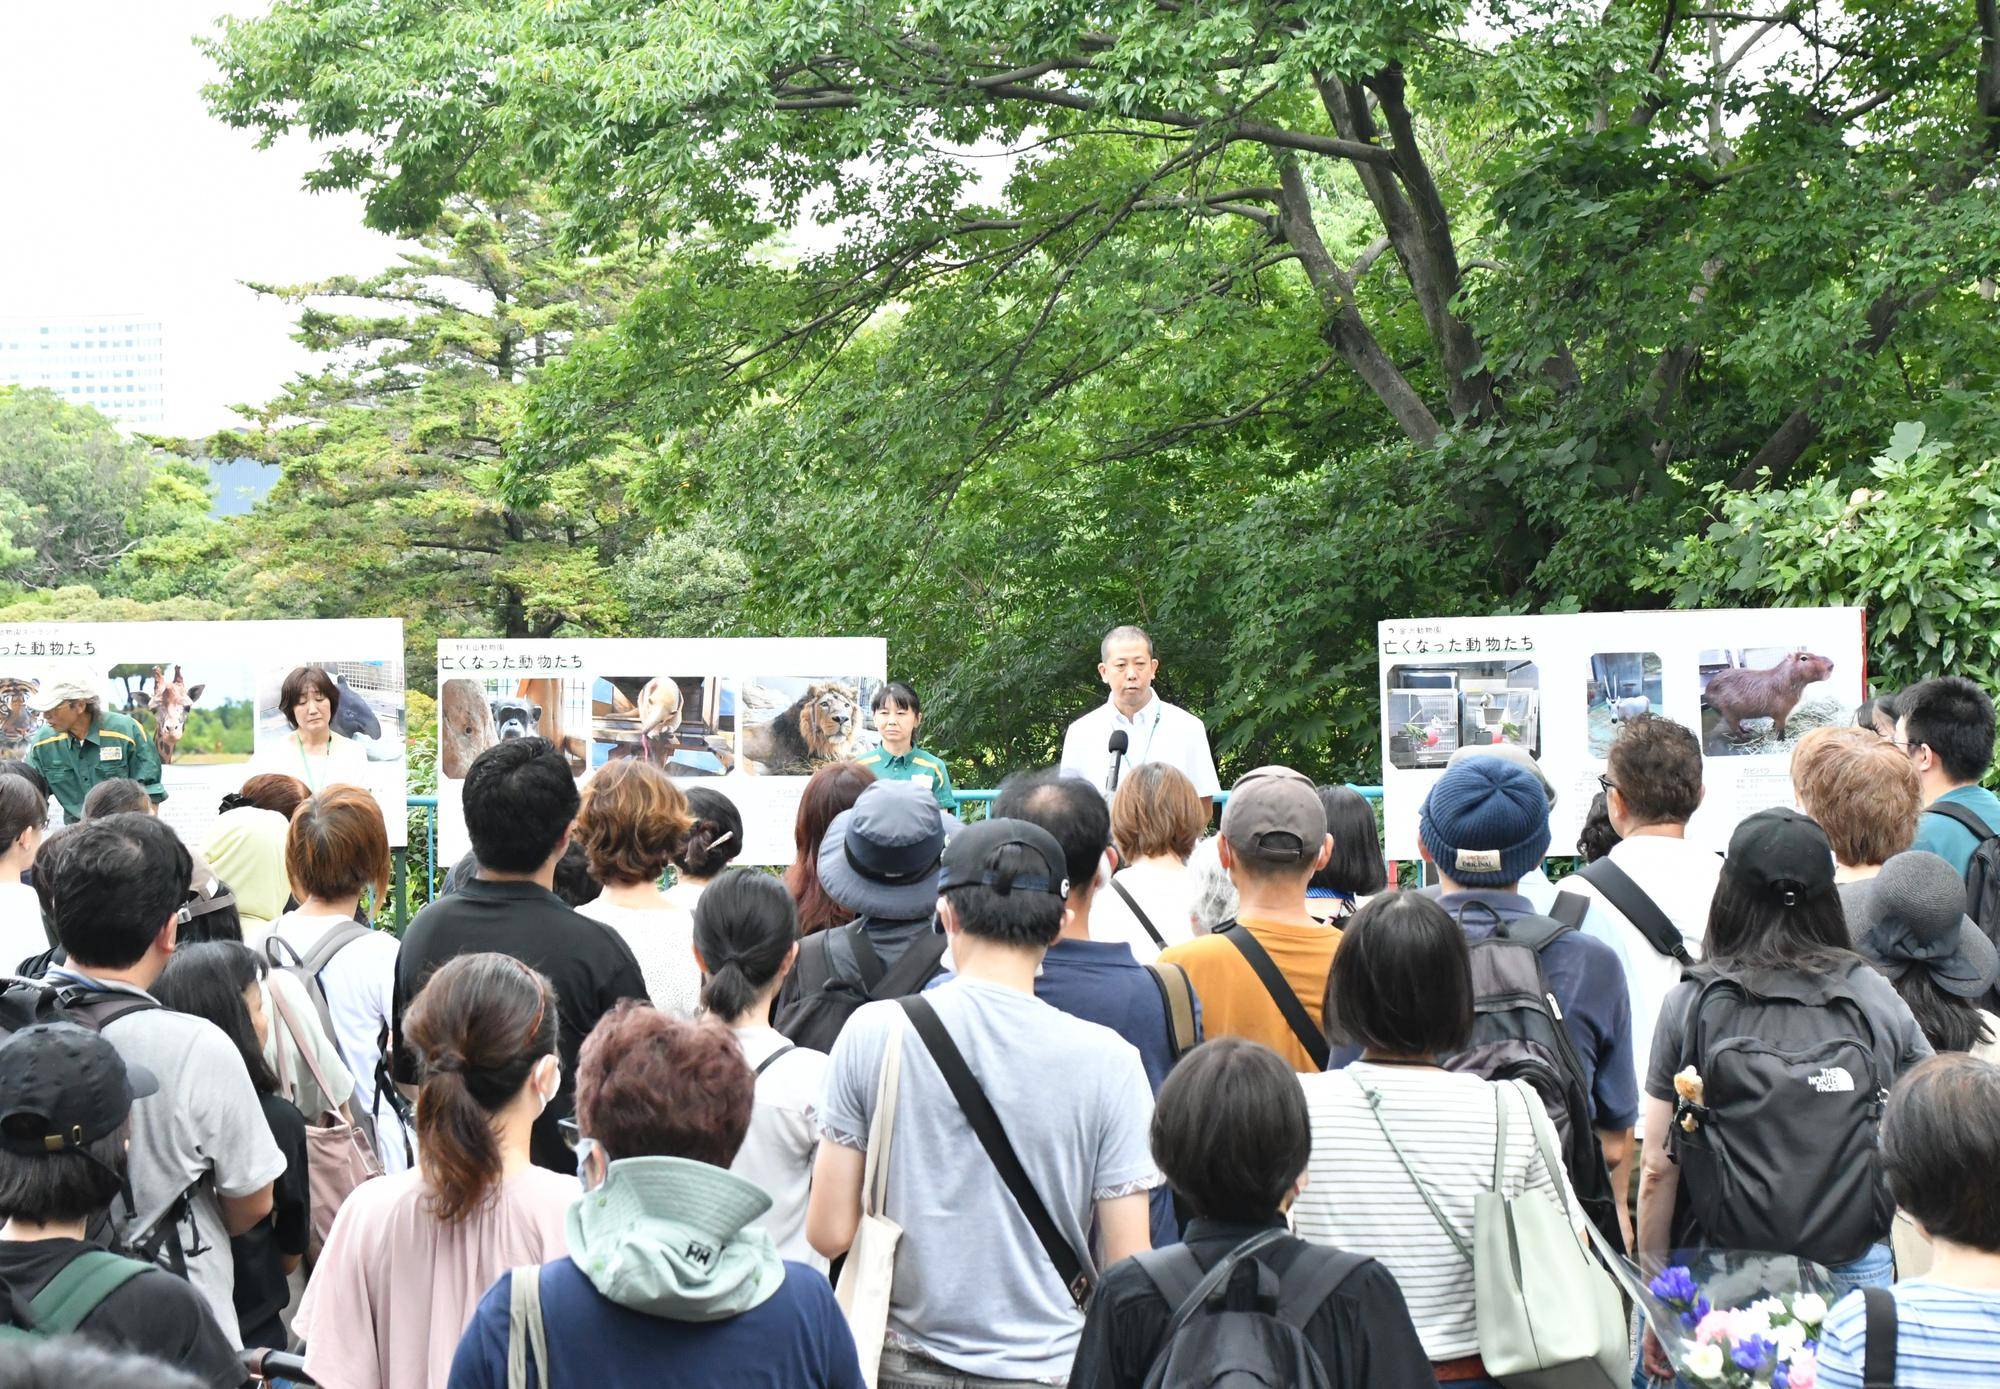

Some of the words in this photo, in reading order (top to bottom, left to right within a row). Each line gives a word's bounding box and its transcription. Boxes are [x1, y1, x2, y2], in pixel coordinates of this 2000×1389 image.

[0, 641, 97, 656] った動物たち
[1383, 635, 1534, 655] 亡くなった動物たち
[439, 654, 584, 670] 亡くなった動物たち
[1820, 1067, 1839, 1076] THE
[1808, 1076, 1839, 1085] NORTH
[1816, 1084, 1839, 1092] FACE
[685, 1242, 712, 1267] HH
